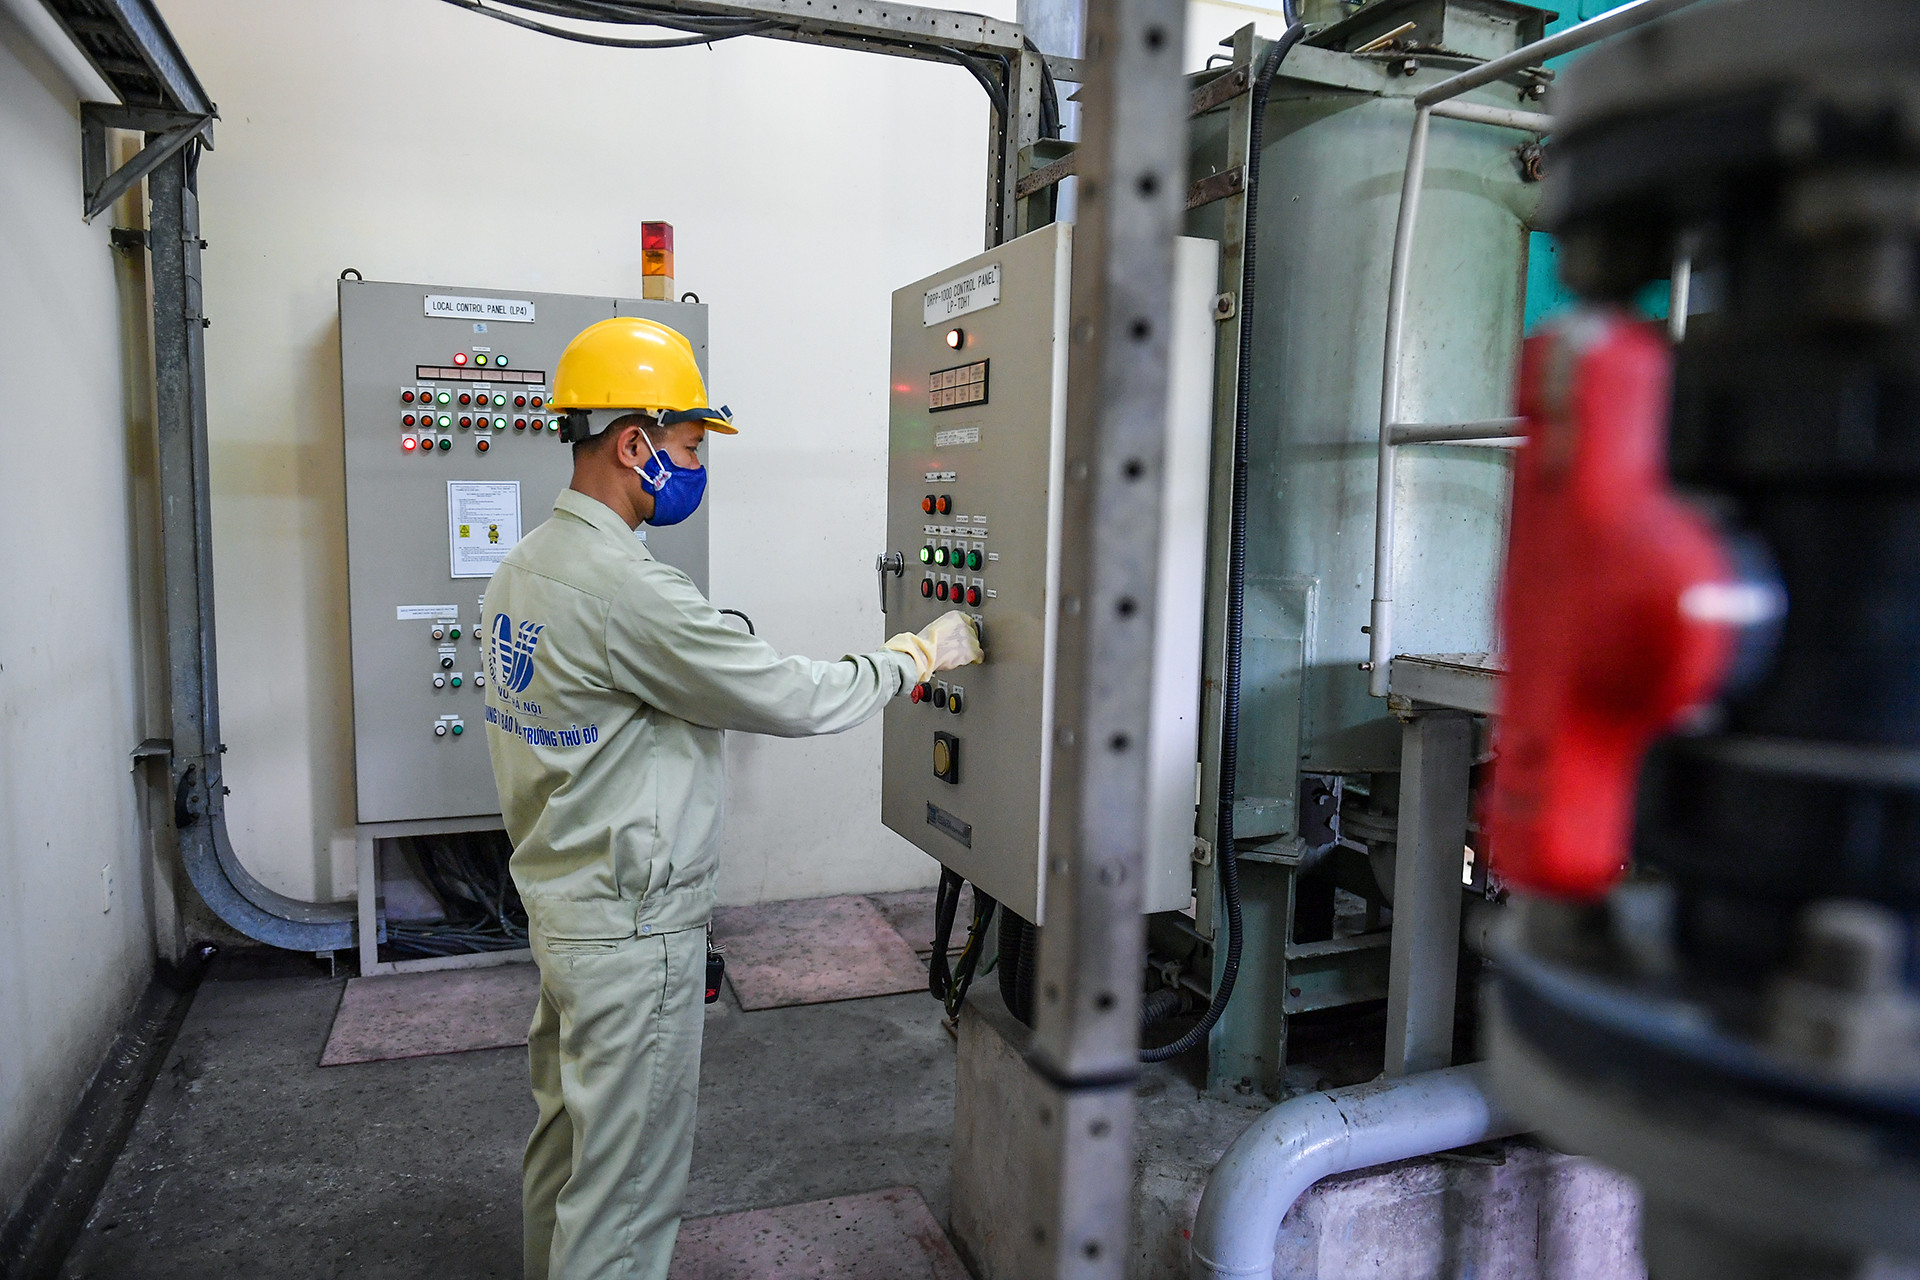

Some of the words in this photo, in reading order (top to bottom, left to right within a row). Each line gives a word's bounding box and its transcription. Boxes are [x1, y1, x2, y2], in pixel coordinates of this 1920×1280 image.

[953, 278, 976, 297] CONTROL
[978, 271, 996, 288] PANEL
[432, 301, 453, 311] LOCAL
[456, 302, 485, 314] CONTROL
[487, 304, 507, 315] PANEL
[509, 306, 527, 316] (LP4)
[523, 701, 542, 717] NỘI
[522, 725, 558, 747] TRƯỜNG
[558, 724, 581, 747] THỦ
[582, 723, 599, 745] ĐÔ
